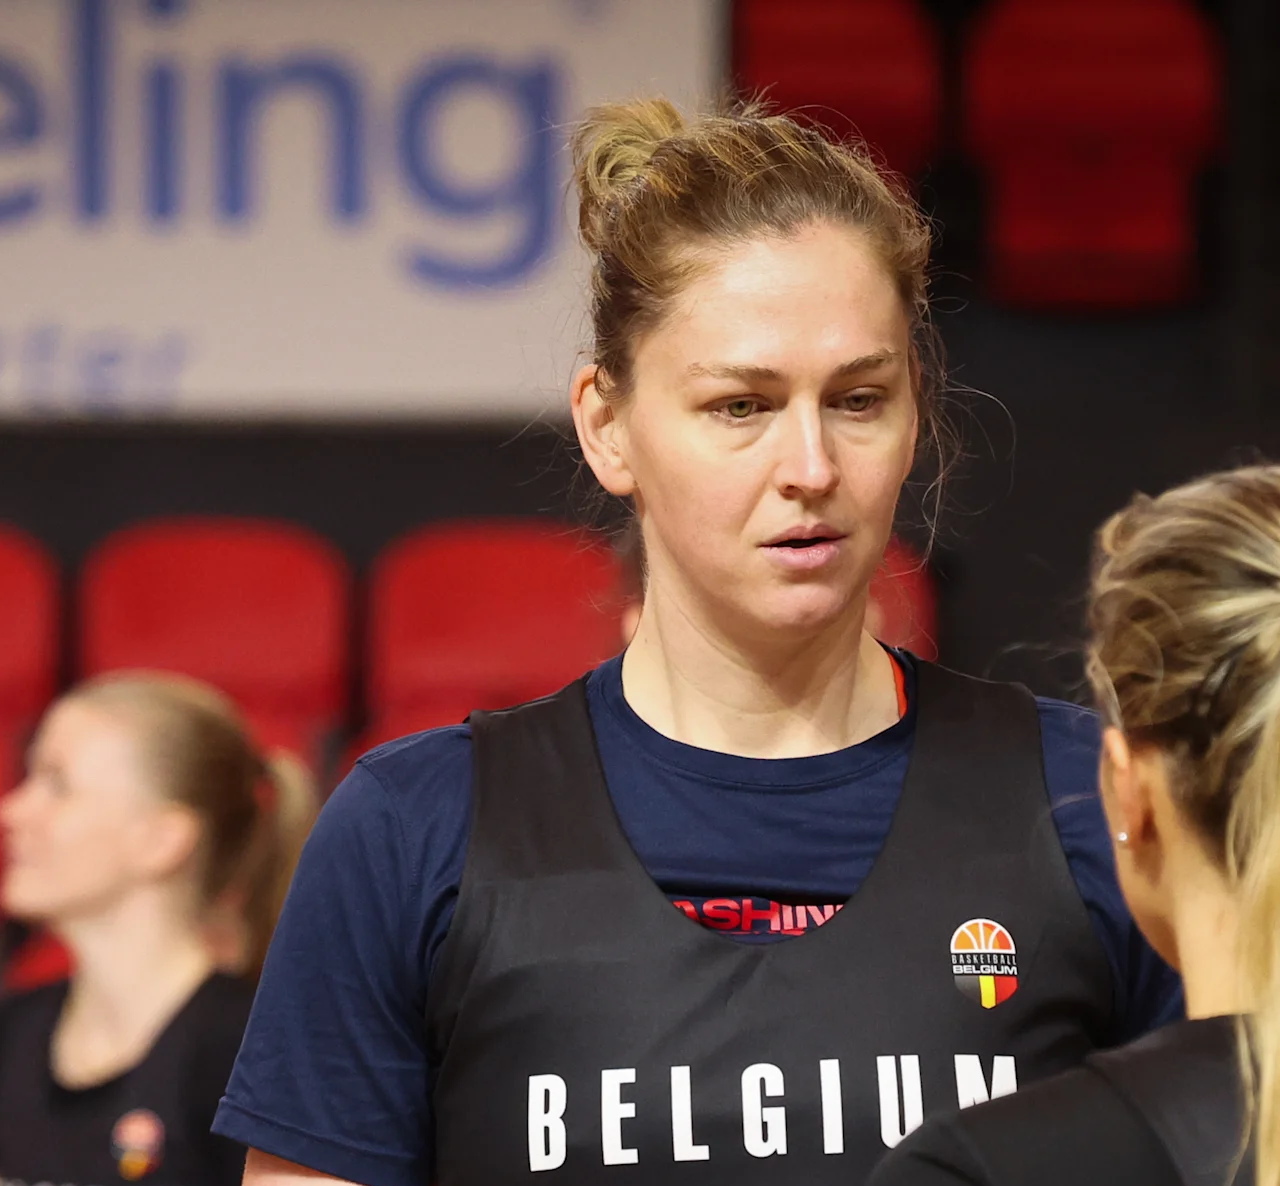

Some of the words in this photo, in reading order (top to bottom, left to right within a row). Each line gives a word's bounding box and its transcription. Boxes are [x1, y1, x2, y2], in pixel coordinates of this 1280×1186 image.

[951, 954, 1017, 965] BASKETBALL
[952, 965, 1018, 975] BELGIUM
[528, 1054, 1018, 1172] BELGIUM
